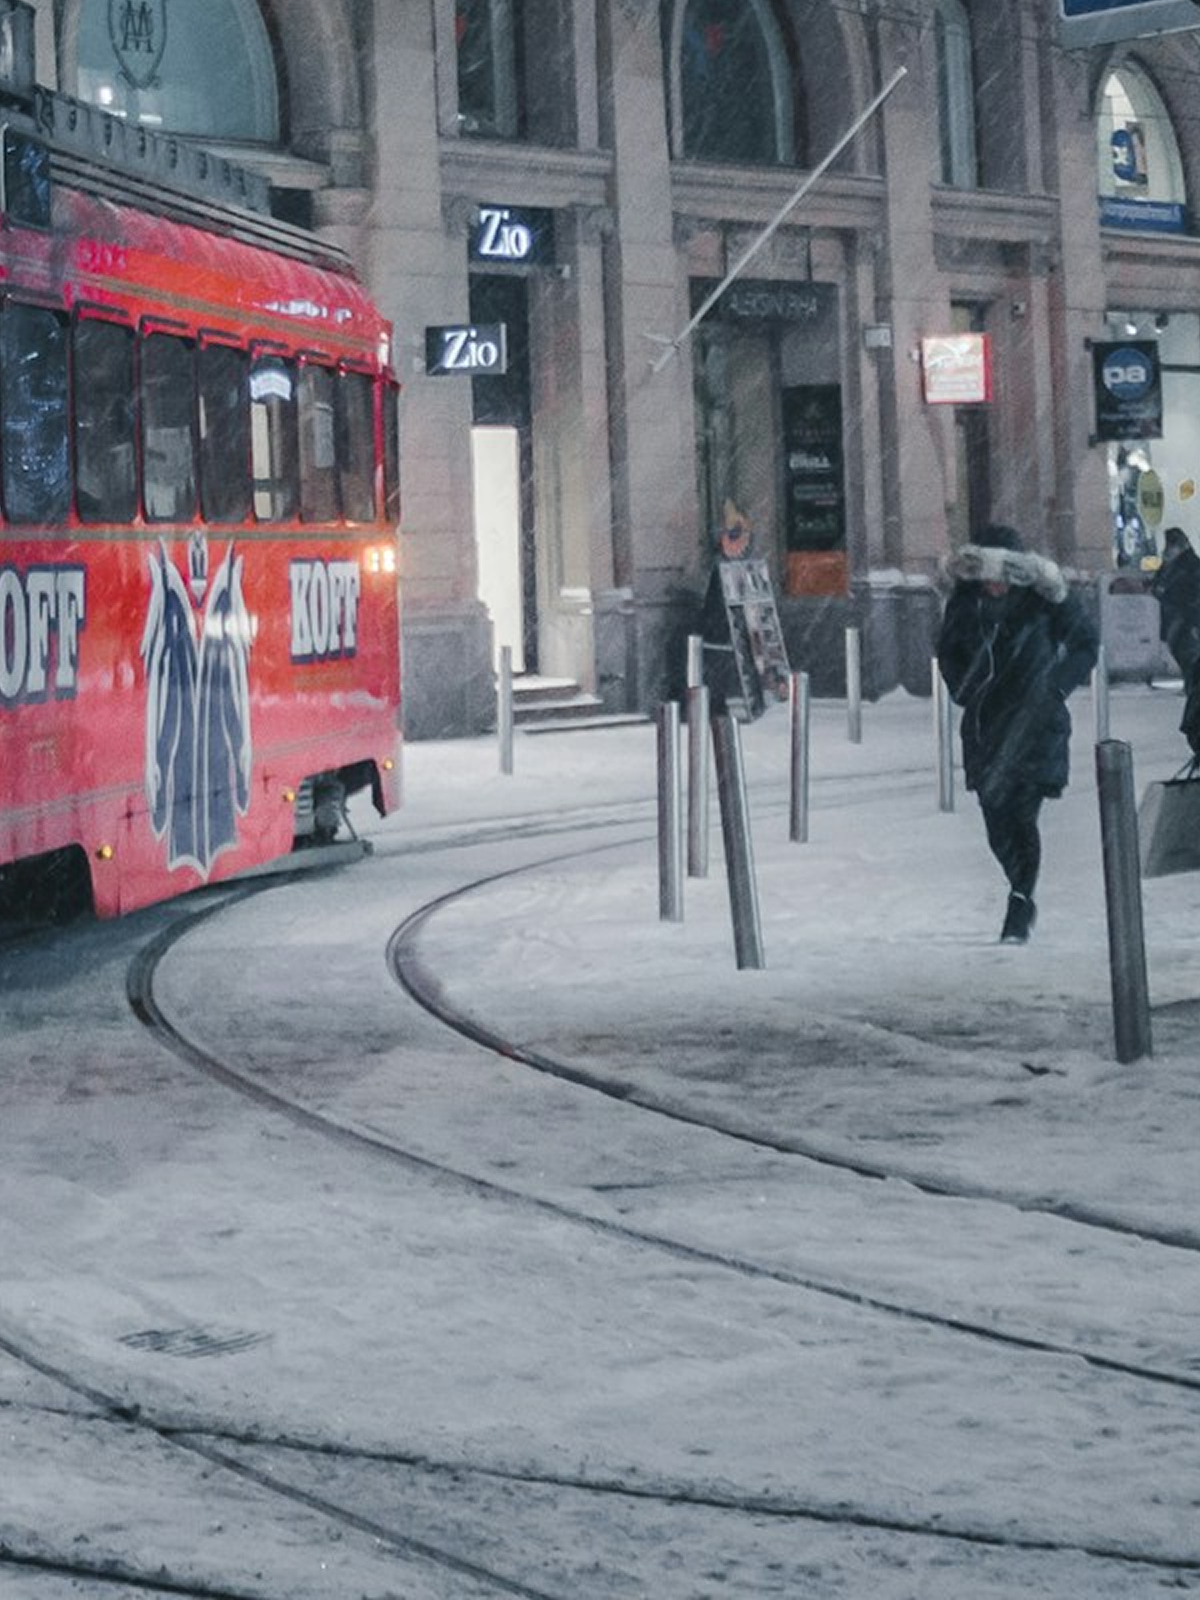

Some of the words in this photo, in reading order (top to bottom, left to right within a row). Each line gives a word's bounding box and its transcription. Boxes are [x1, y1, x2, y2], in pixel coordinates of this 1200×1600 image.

[479, 208, 531, 258] Zio
[443, 328, 499, 369] Zio
[289, 558, 361, 662] KOFF
